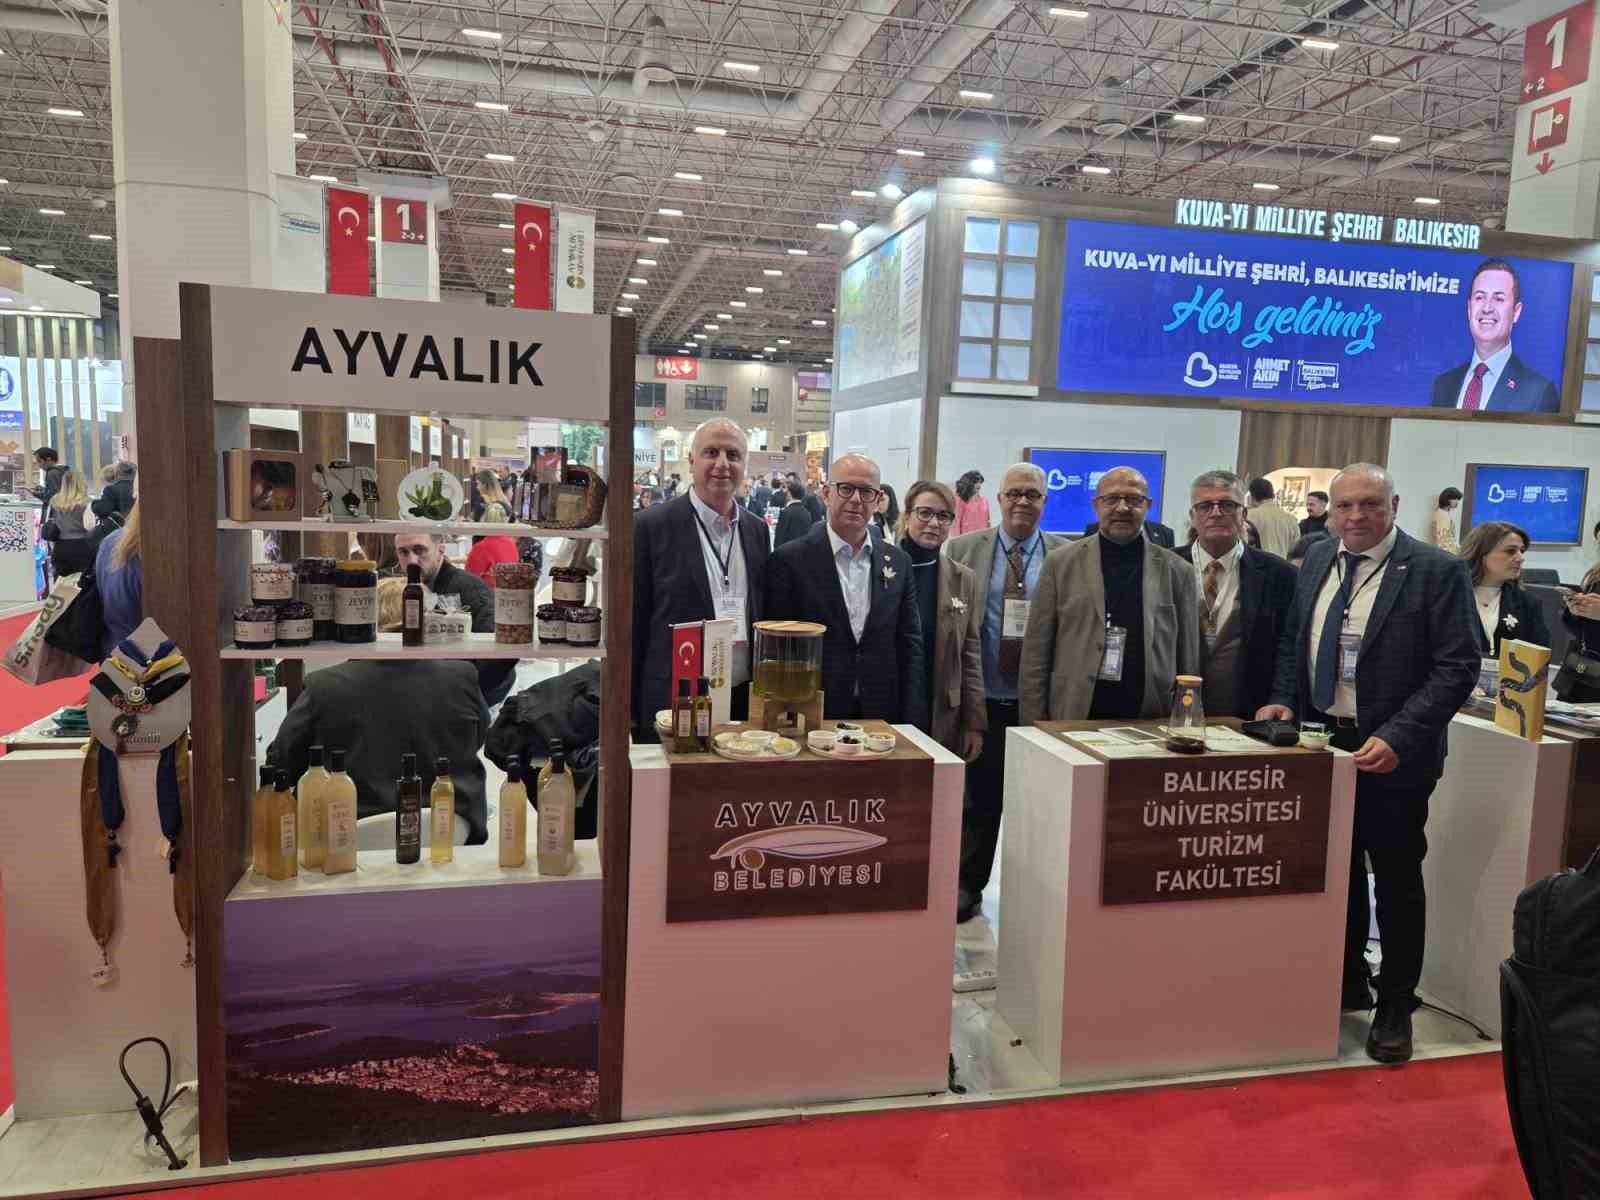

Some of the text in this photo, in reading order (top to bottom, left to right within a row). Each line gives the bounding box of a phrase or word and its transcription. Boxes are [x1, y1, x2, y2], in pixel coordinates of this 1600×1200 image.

[1545, 17, 1567, 69] 1
[396, 203, 410, 231] 1
[1084, 249, 1166, 272] KUVA-YI
[1170, 252, 1247, 278] MİLLİYE
[1251, 261, 1310, 286] ŞEHRİ,
[1242, 296, 1382, 355] geldiniz
[291, 327, 544, 386] AYVALIK
[1164, 764, 1286, 793] BALIKESİR
[714, 799, 886, 828] AYVALIK
[1143, 795, 1301, 826] ÜNİVERSİTESİ
[1178, 830, 1264, 858] TURİZM
[1156, 860, 1282, 892] FAKÜLTESİ
